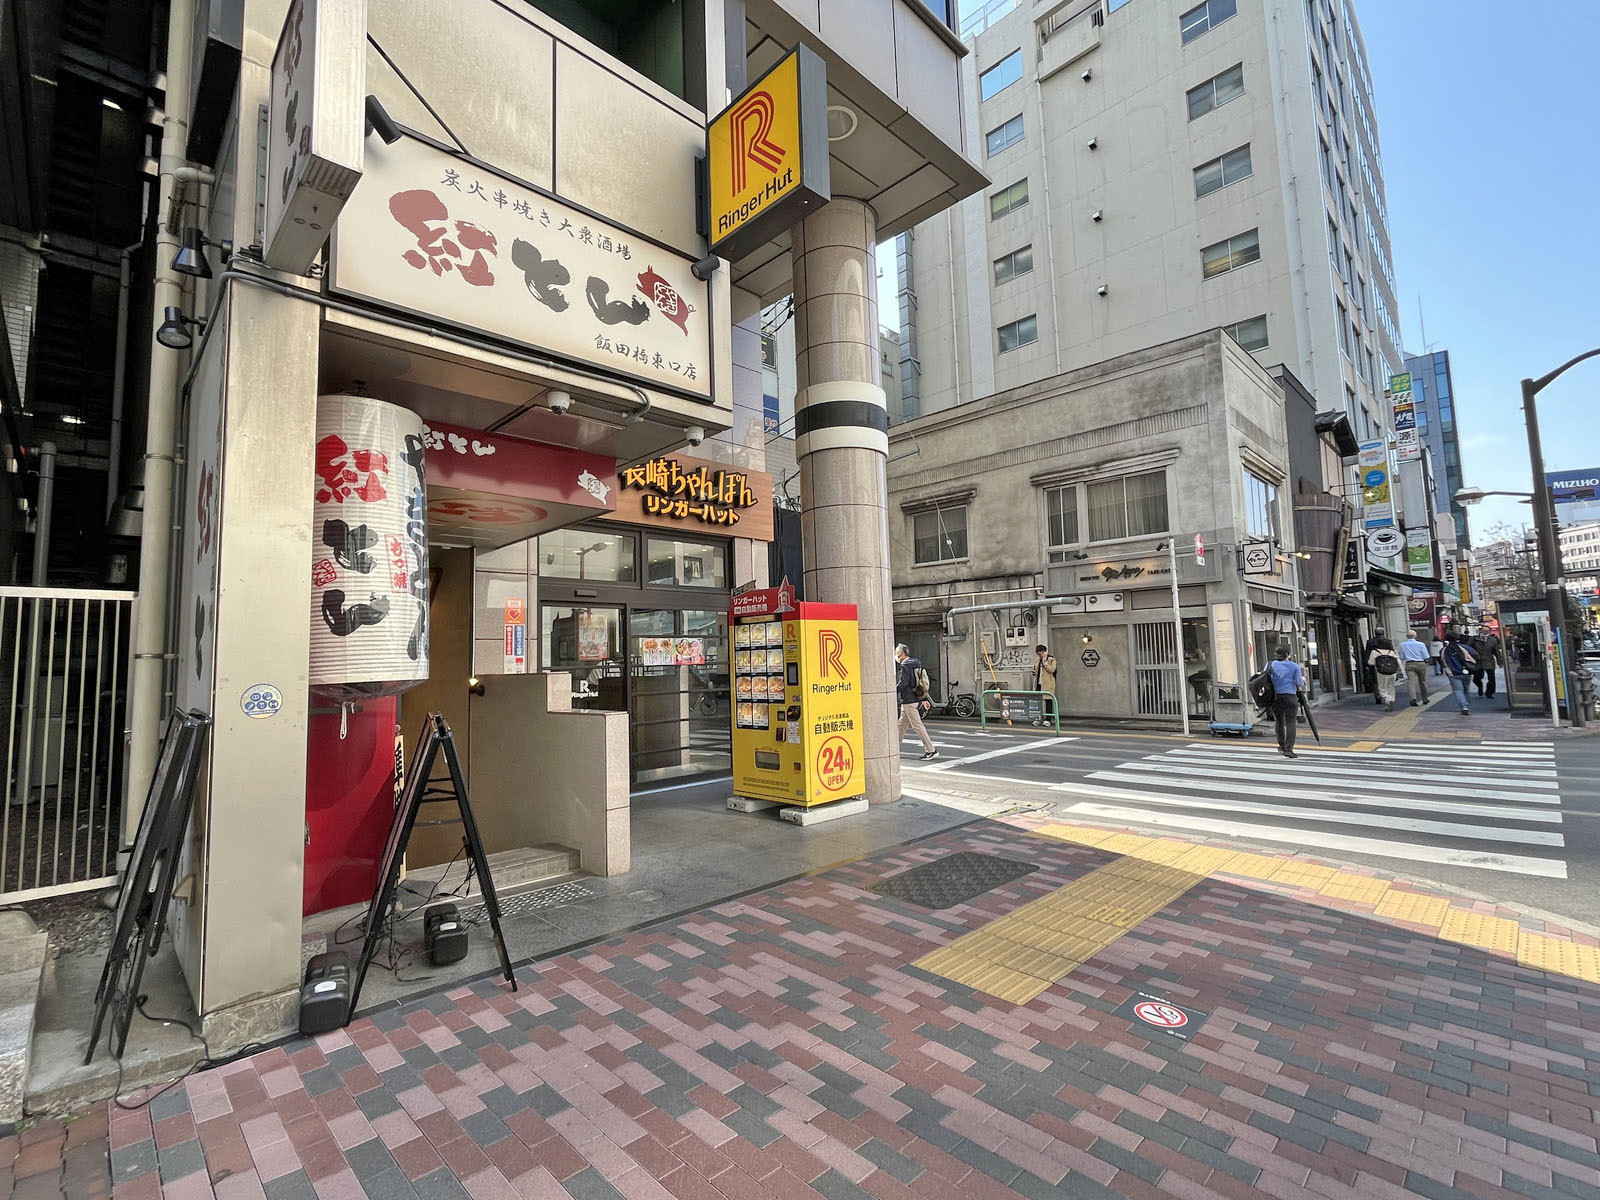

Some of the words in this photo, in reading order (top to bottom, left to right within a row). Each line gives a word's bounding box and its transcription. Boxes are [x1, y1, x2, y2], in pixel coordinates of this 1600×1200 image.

[718, 190, 764, 234] Ringer
[765, 167, 793, 201] Hut
[440, 168, 632, 261] 炭火串焼き大衆酒場
[594, 334, 698, 382] 飯田橋東口店
[1553, 478, 1599, 489] MIZUHO
[646, 495, 741, 525] リンガーハット
[733, 594, 768, 606] リンガーハット
[812, 682, 838, 695] Ringer
[838, 681, 852, 693] Hut
[814, 719, 854, 735] 自動販売機
[827, 774, 844, 786] OPEN
